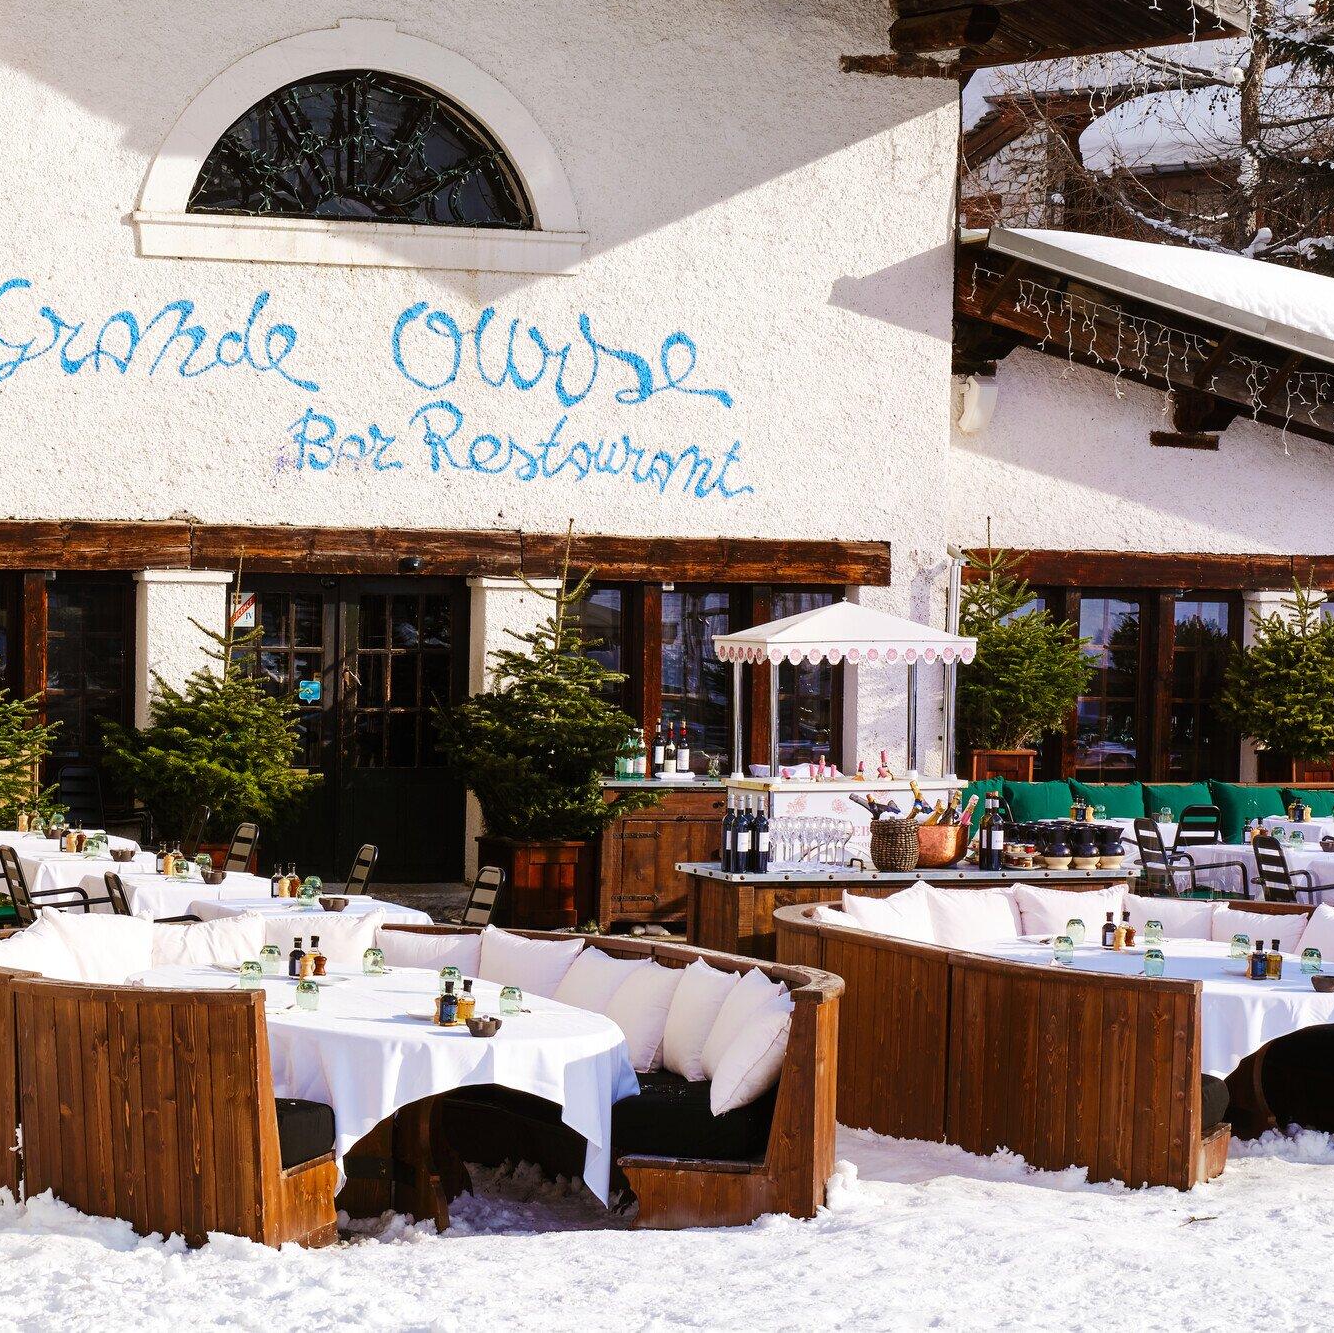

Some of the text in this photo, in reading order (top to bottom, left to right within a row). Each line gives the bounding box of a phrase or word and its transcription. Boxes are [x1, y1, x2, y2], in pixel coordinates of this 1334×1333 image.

[390, 300, 733, 409] Ourse
[287, 399, 754, 499] Bar Restaurant
